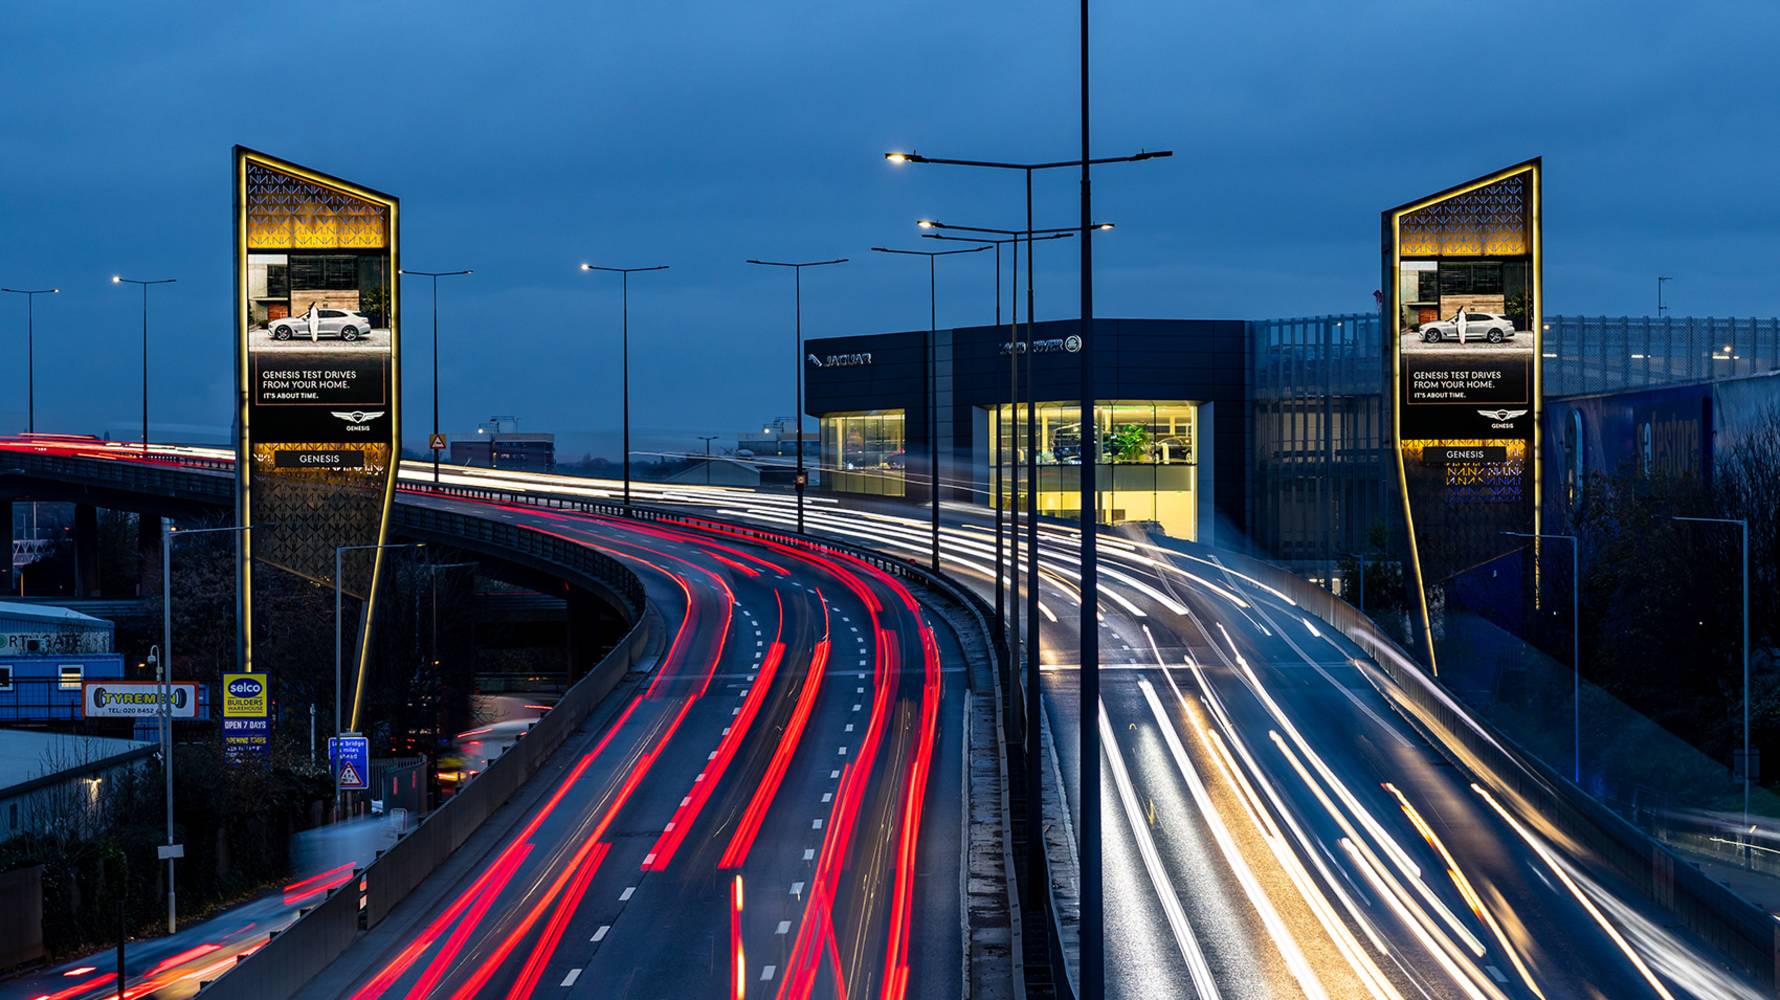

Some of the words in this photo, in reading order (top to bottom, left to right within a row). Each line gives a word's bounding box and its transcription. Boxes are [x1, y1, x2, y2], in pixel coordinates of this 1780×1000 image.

[824, 353, 871, 367] JAGUAR
[263, 371, 300, 379] GENESIS
[303, 371, 322, 379] TEST
[325, 371, 356, 379] DRIVES
[230, 682, 260, 692] selco
[225, 721, 242, 729] OPEN
[250, 721, 266, 729] DAYS
